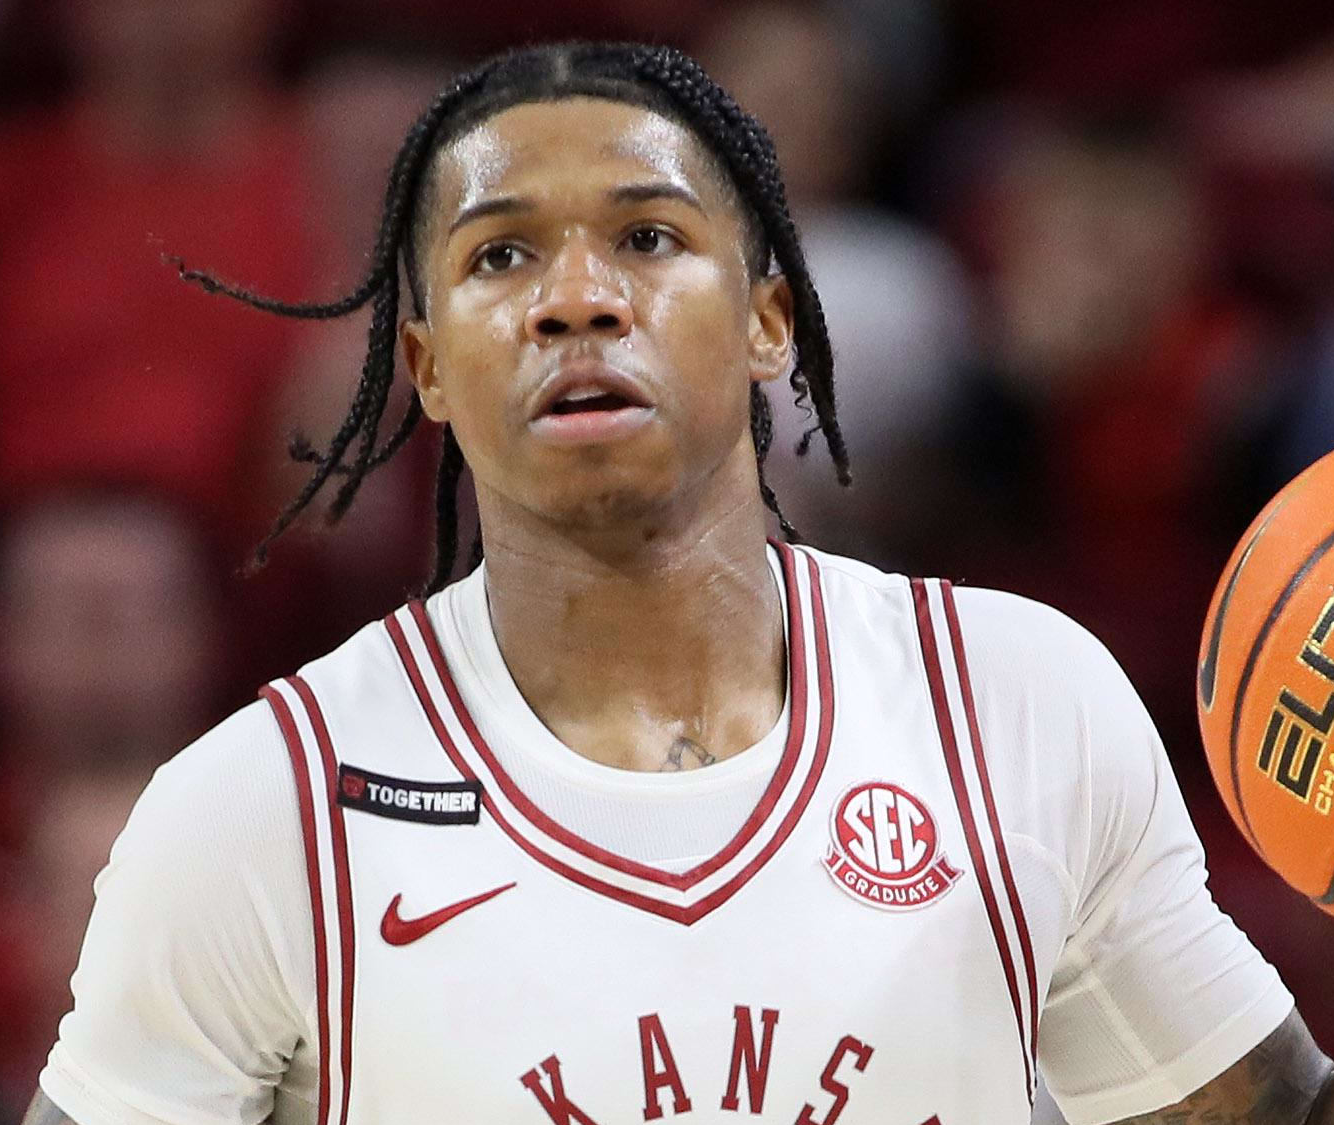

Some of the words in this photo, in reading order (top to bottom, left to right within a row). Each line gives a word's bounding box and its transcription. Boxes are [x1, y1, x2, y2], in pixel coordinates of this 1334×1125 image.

[367, 782, 476, 813] TOGETHER
[842, 787, 928, 874] SEC
[844, 870, 940, 903] GRADUATE
